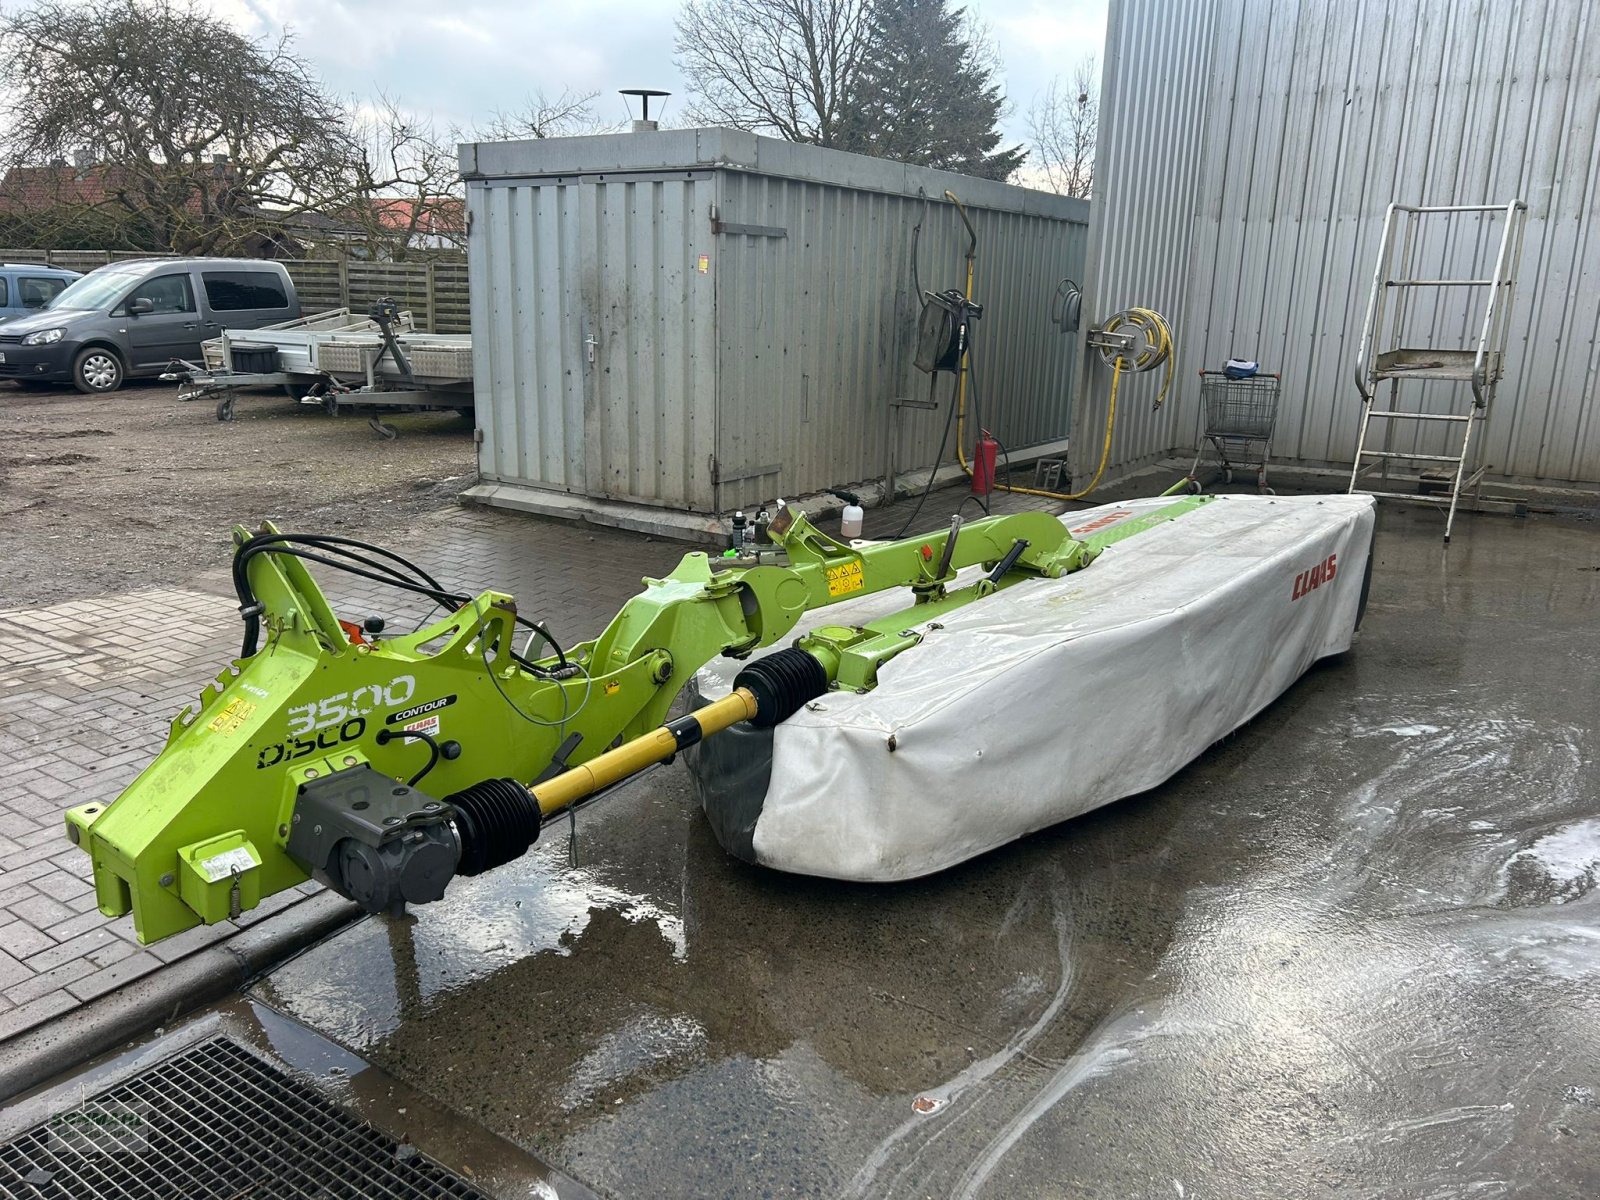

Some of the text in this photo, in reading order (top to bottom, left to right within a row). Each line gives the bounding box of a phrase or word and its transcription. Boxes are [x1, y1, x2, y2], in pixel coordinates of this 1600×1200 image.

[1291, 553, 1337, 602] CLAAS
[287, 675, 416, 737] 3500
[395, 698, 447, 721] CONTOUR
[256, 717, 366, 769] DISCO
